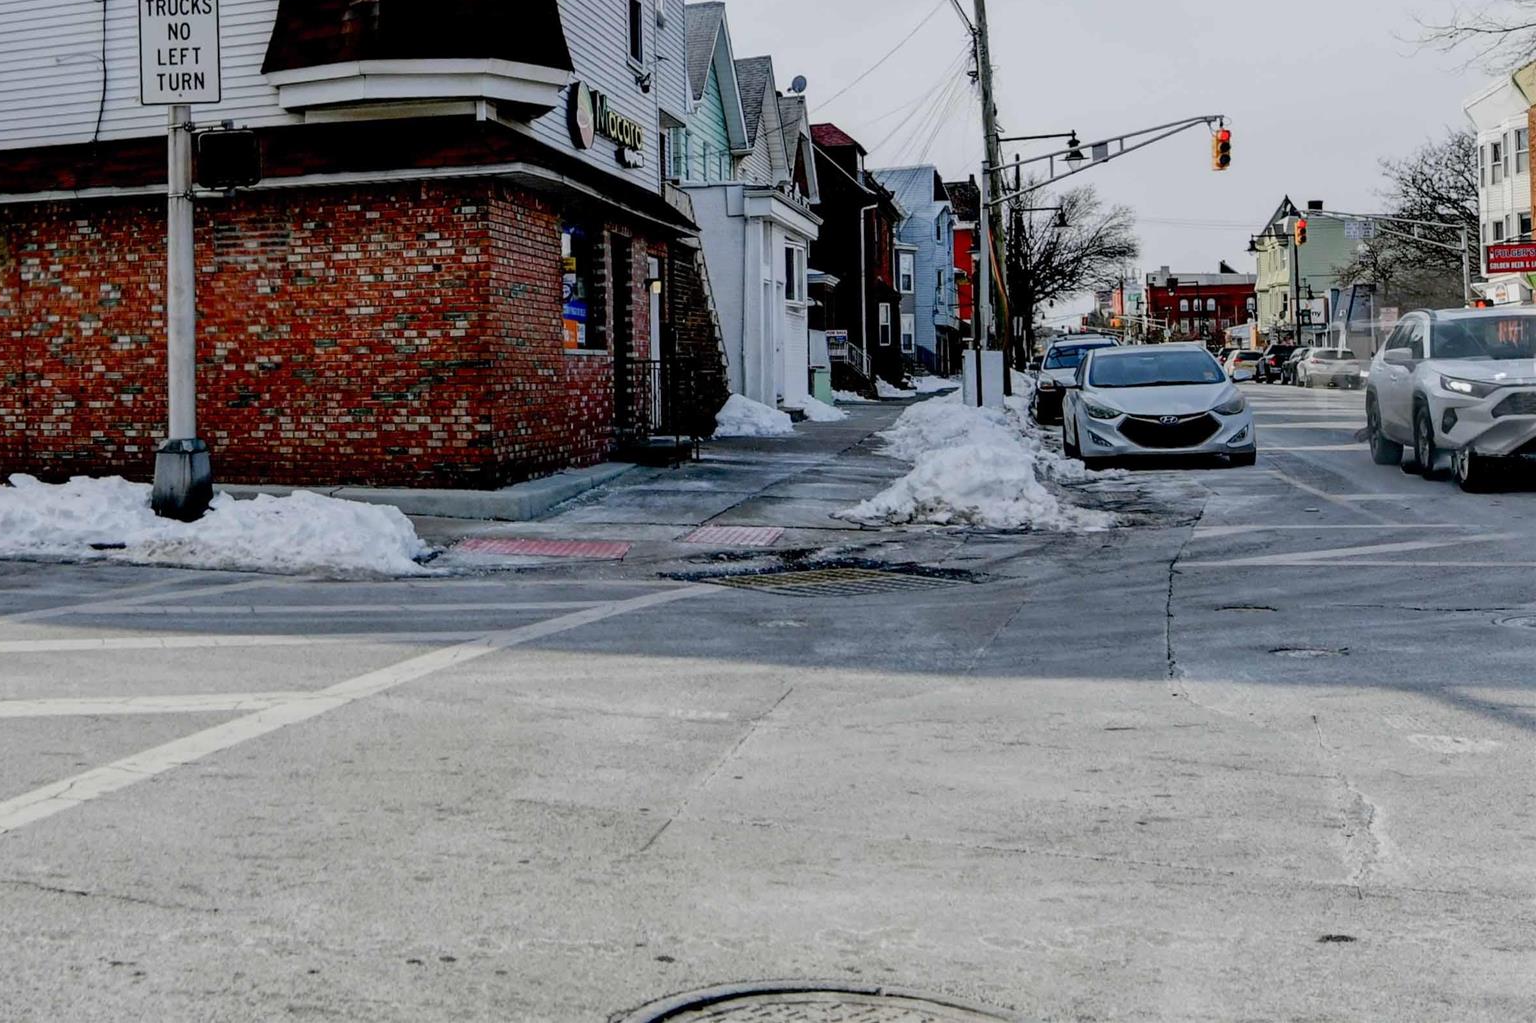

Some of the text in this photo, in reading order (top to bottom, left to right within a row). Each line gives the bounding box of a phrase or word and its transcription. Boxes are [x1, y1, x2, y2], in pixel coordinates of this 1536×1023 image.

[167, 22, 191, 40] NO
[157, 47, 202, 66] LEFT
[156, 72, 205, 91] TURN
[595, 91, 643, 150] Macara
